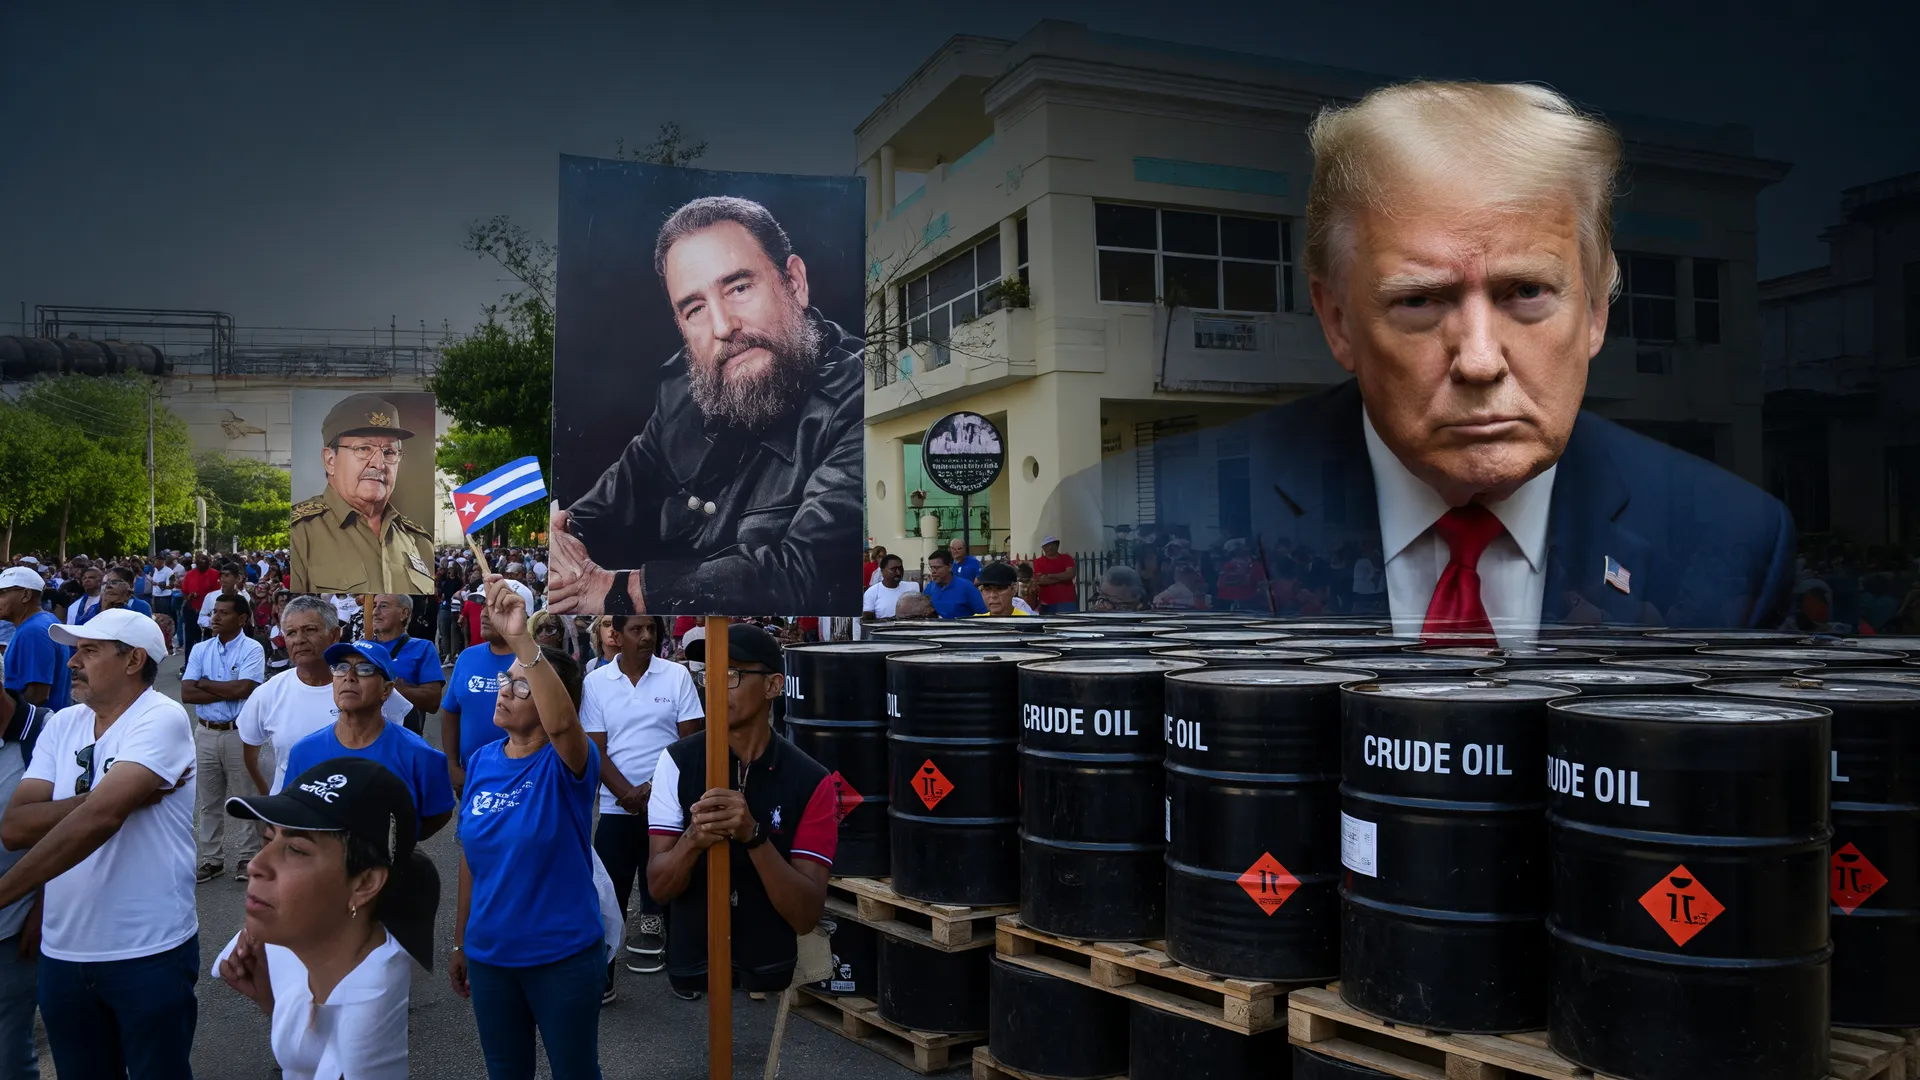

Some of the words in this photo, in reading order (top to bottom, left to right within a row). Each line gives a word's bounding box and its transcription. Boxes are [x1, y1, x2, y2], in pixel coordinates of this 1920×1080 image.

[785, 675, 804, 699] OIL
[1023, 703, 1084, 735] CRUDE
[1094, 709, 1139, 736] OIL
[1177, 719, 1208, 751] OIL
[1364, 735, 1450, 774] CRUDE
[1462, 743, 1512, 775] OIL
[1594, 767, 1650, 807] OIL
